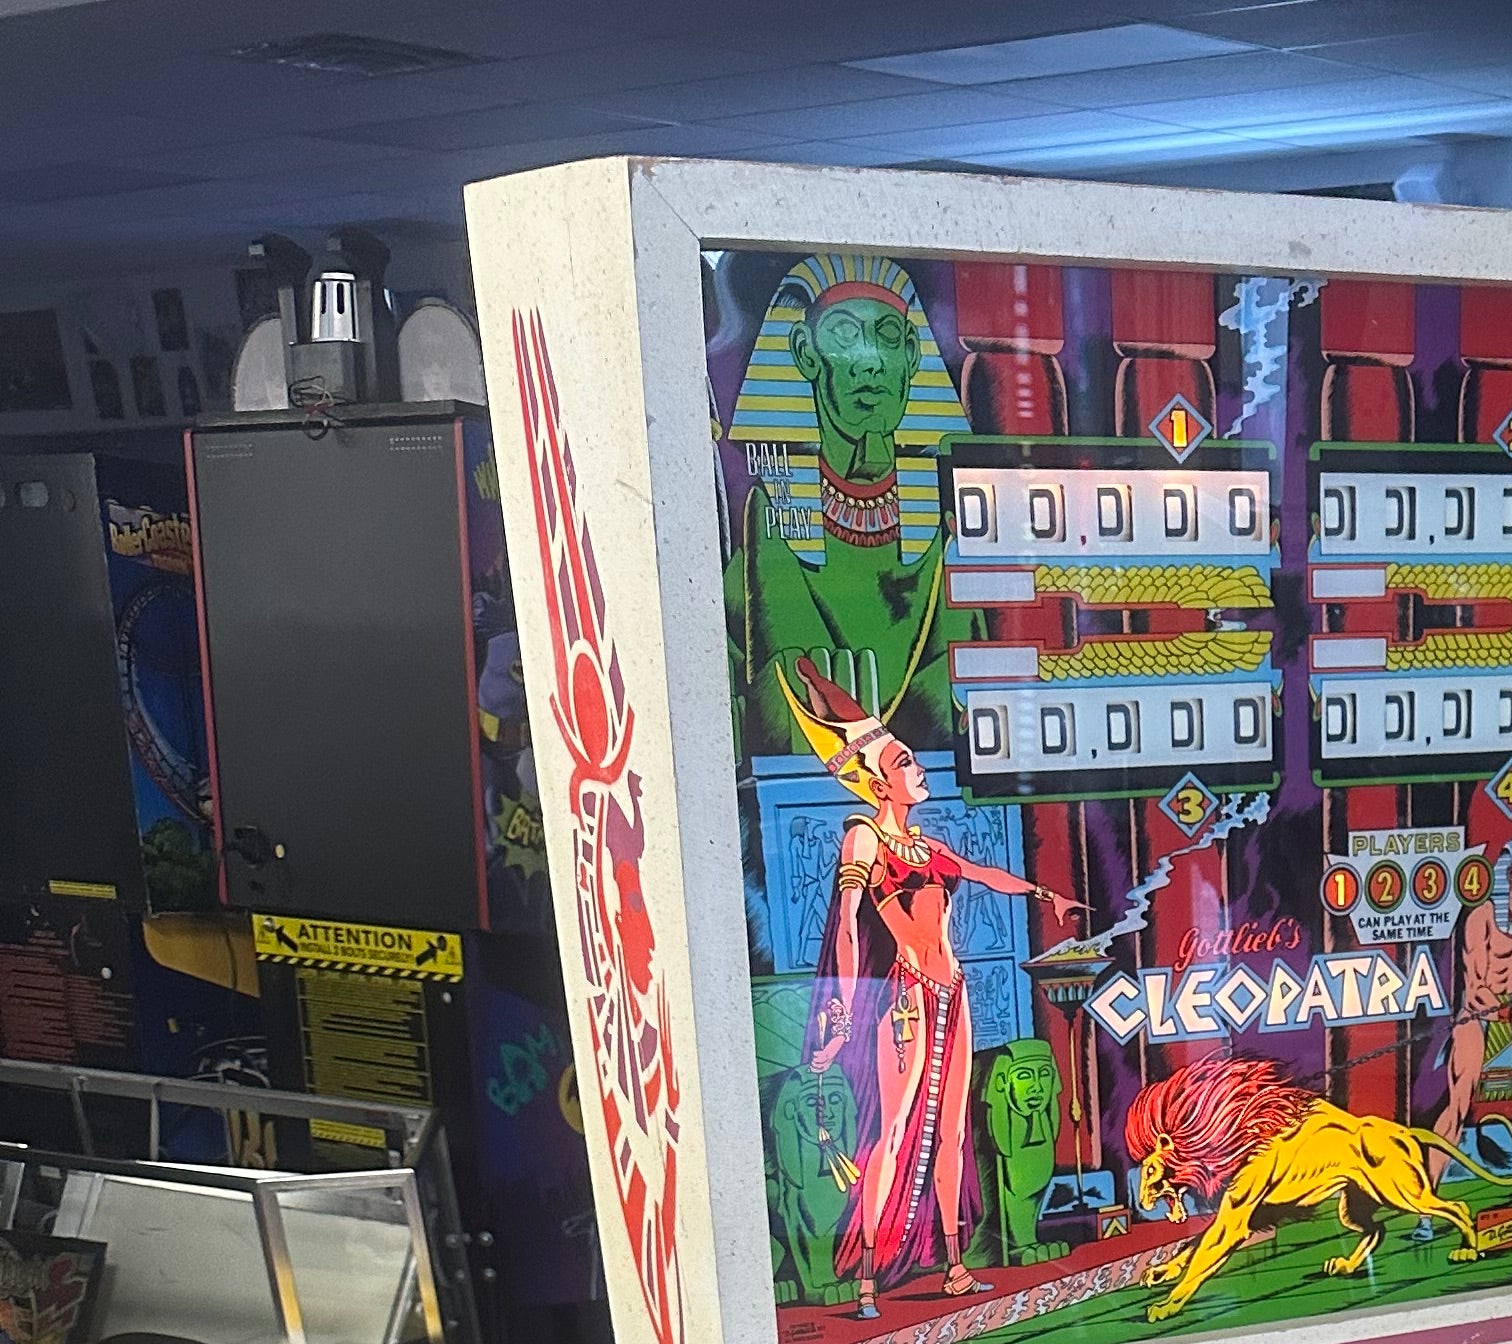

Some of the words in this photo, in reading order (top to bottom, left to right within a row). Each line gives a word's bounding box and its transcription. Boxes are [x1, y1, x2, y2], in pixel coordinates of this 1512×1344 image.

[1171, 408, 1189, 448] 1
[746, 443, 793, 477] BALL
[774, 479, 791, 504] IN
[765, 506, 811, 540] PLAY
[1176, 790, 1203, 824] 3
[1352, 832, 1461, 856] PLAYERS
[1334, 873, 1345, 906] 1
[1377, 871, 1394, 902] 2
[1422, 868, 1437, 899] 3
[1464, 866, 1481, 895] 4
[1358, 917, 1380, 928] CAN
[1384, 915, 1412, 927] PLAY
[1413, 914, 1426, 925] AT
[1430, 912, 1450, 923] THE
[1372, 928, 1402, 940] SAME
[1406, 926, 1433, 938] TIME
[299, 925, 412, 950] ATTENTION
[1174, 918, 1301, 974] Gottlieb's
[1087, 949, 1447, 1042] CLEOPATRA
